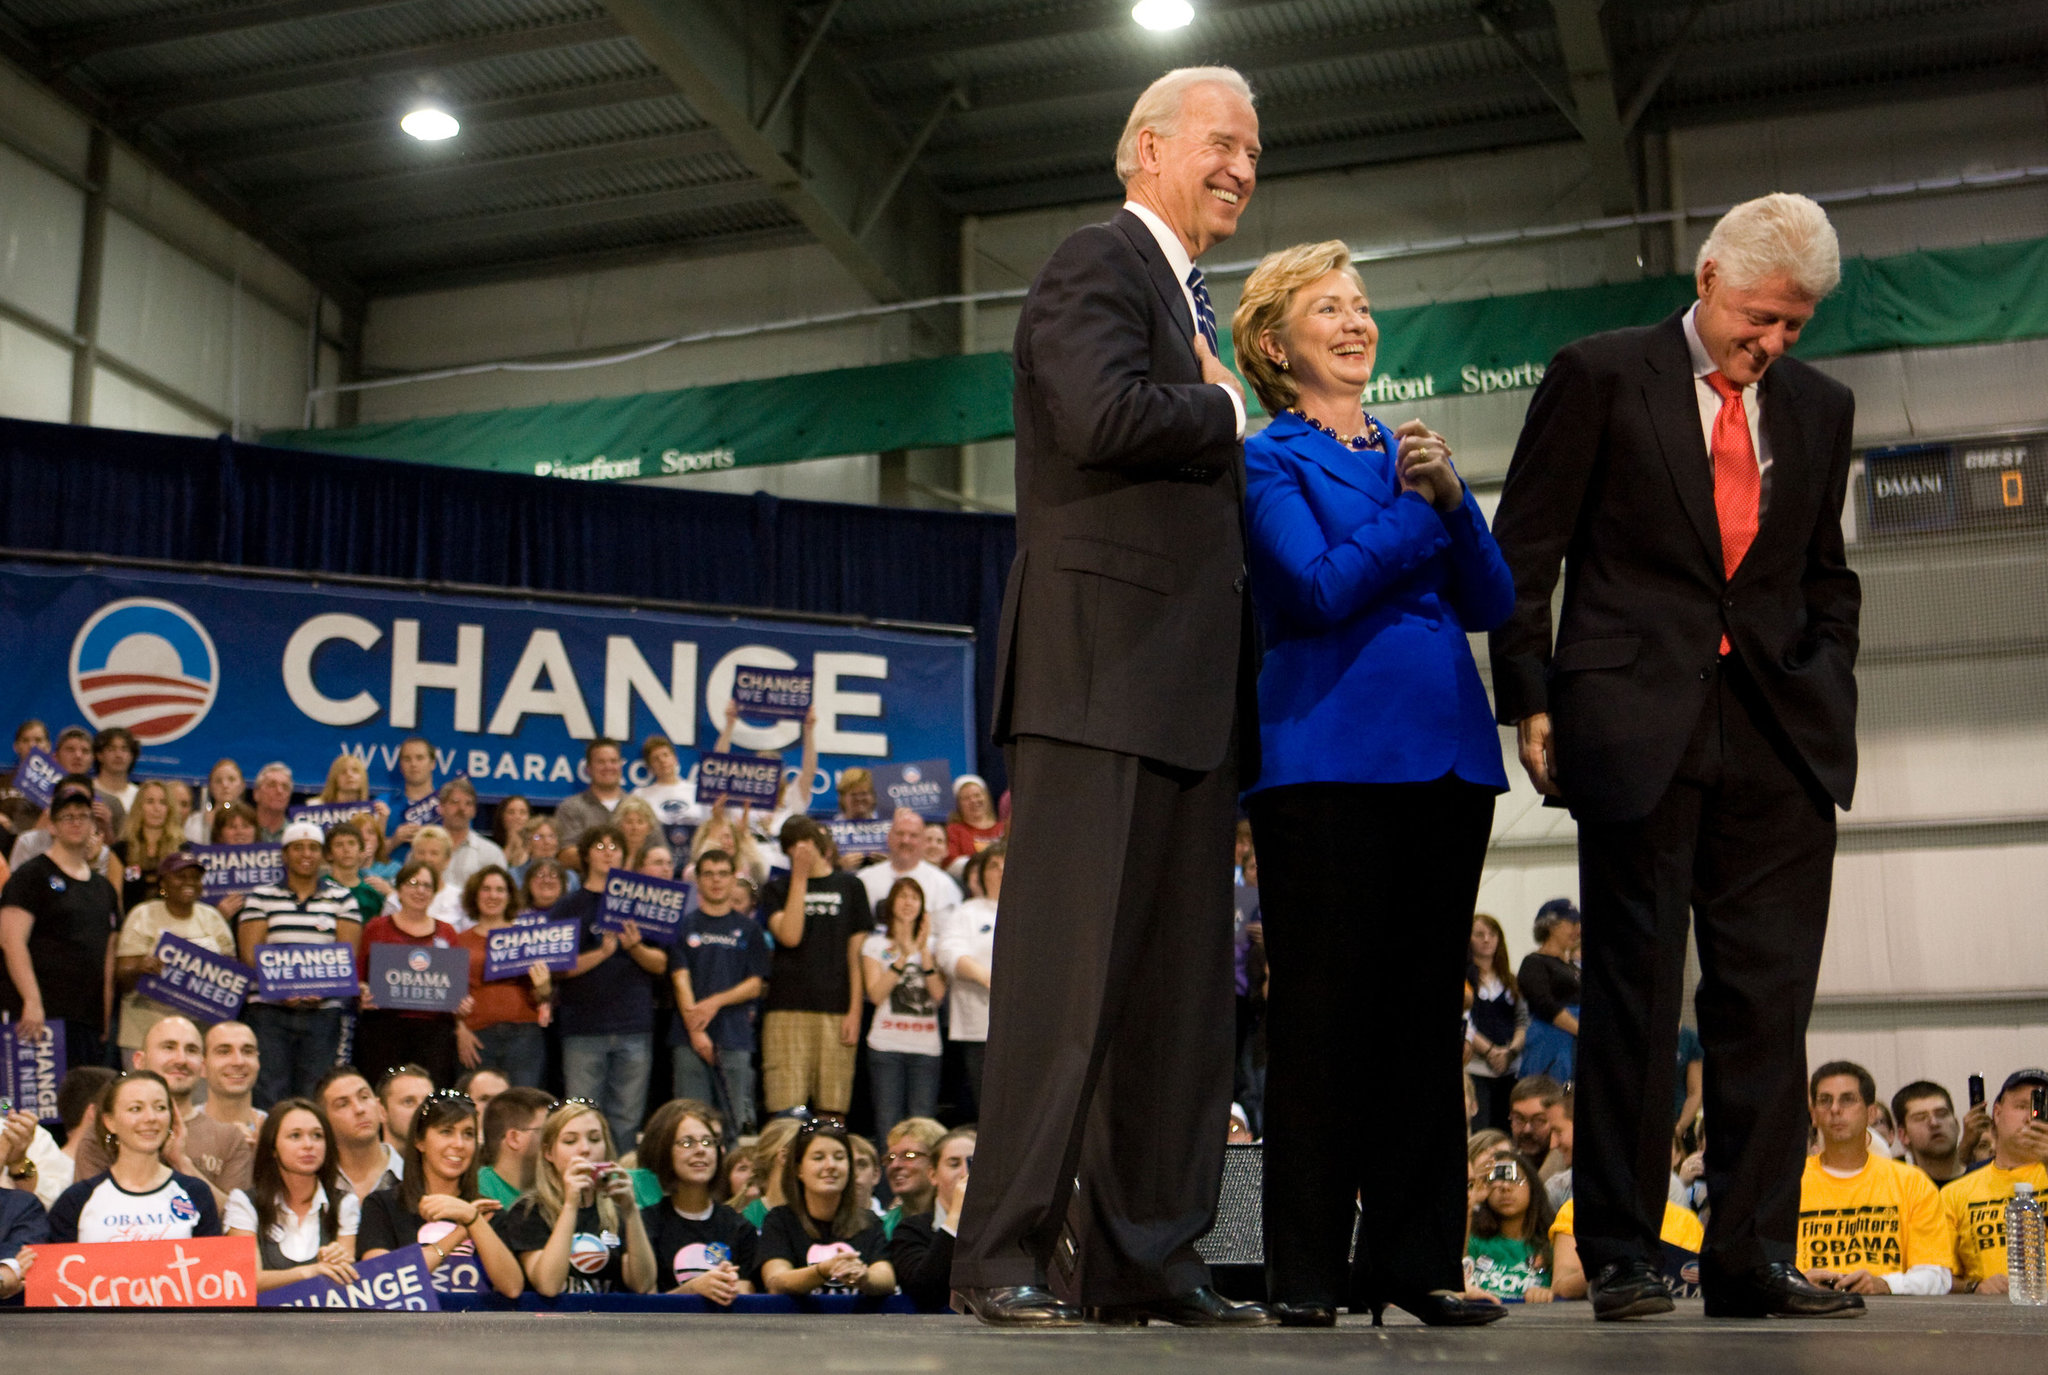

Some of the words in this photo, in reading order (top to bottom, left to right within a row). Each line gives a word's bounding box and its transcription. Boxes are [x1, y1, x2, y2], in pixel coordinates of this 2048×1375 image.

[1360, 372, 1435, 403] rfront
[1461, 361, 1546, 394] Sports
[534, 454, 641, 481] Riverfront
[661, 447, 735, 475] Sports
[1877, 472, 1942, 499] DASANI
[282, 612, 889, 757] CHANGE
[737, 671, 811, 694] CHANGE
[736, 688, 762, 703] WE
[767, 691, 809, 706] NEED
[702, 758, 777, 782] CHANGE
[701, 775, 727, 790] WE
[731, 779, 776, 795] NEED
[887, 781, 941, 798] OBAMA
[198, 849, 283, 870] CHANGE
[202, 871, 229, 885] WE
[234, 867, 284, 884] NEED
[608, 877, 686, 910] CHANGE
[606, 895, 632, 914] WE
[633, 902, 680, 924] NEED
[490, 924, 575, 950] CHANGE
[259, 947, 350, 967] CHANGE
[490, 948, 520, 962] WE
[524, 941, 574, 957] NEED
[158, 944, 249, 995] CHANGE
[262, 966, 294, 980] WE
[300, 964, 352, 979] NEED
[385, 968, 451, 988] OBAMA
[186, 975, 239, 1008] NEED
[390, 985, 447, 1000] BIDEN
[103, 1213, 176, 1226] OBAMA
[1803, 1221, 1833, 1238] Fire
[1837, 1217, 1898, 1237] Fighters
[1810, 1237, 1899, 1254] OBAMA
[1811, 1252, 1901, 1268] BIDEN
[53, 1244, 247, 1307] Scranton
[279, 1264, 423, 1308] ANGE
